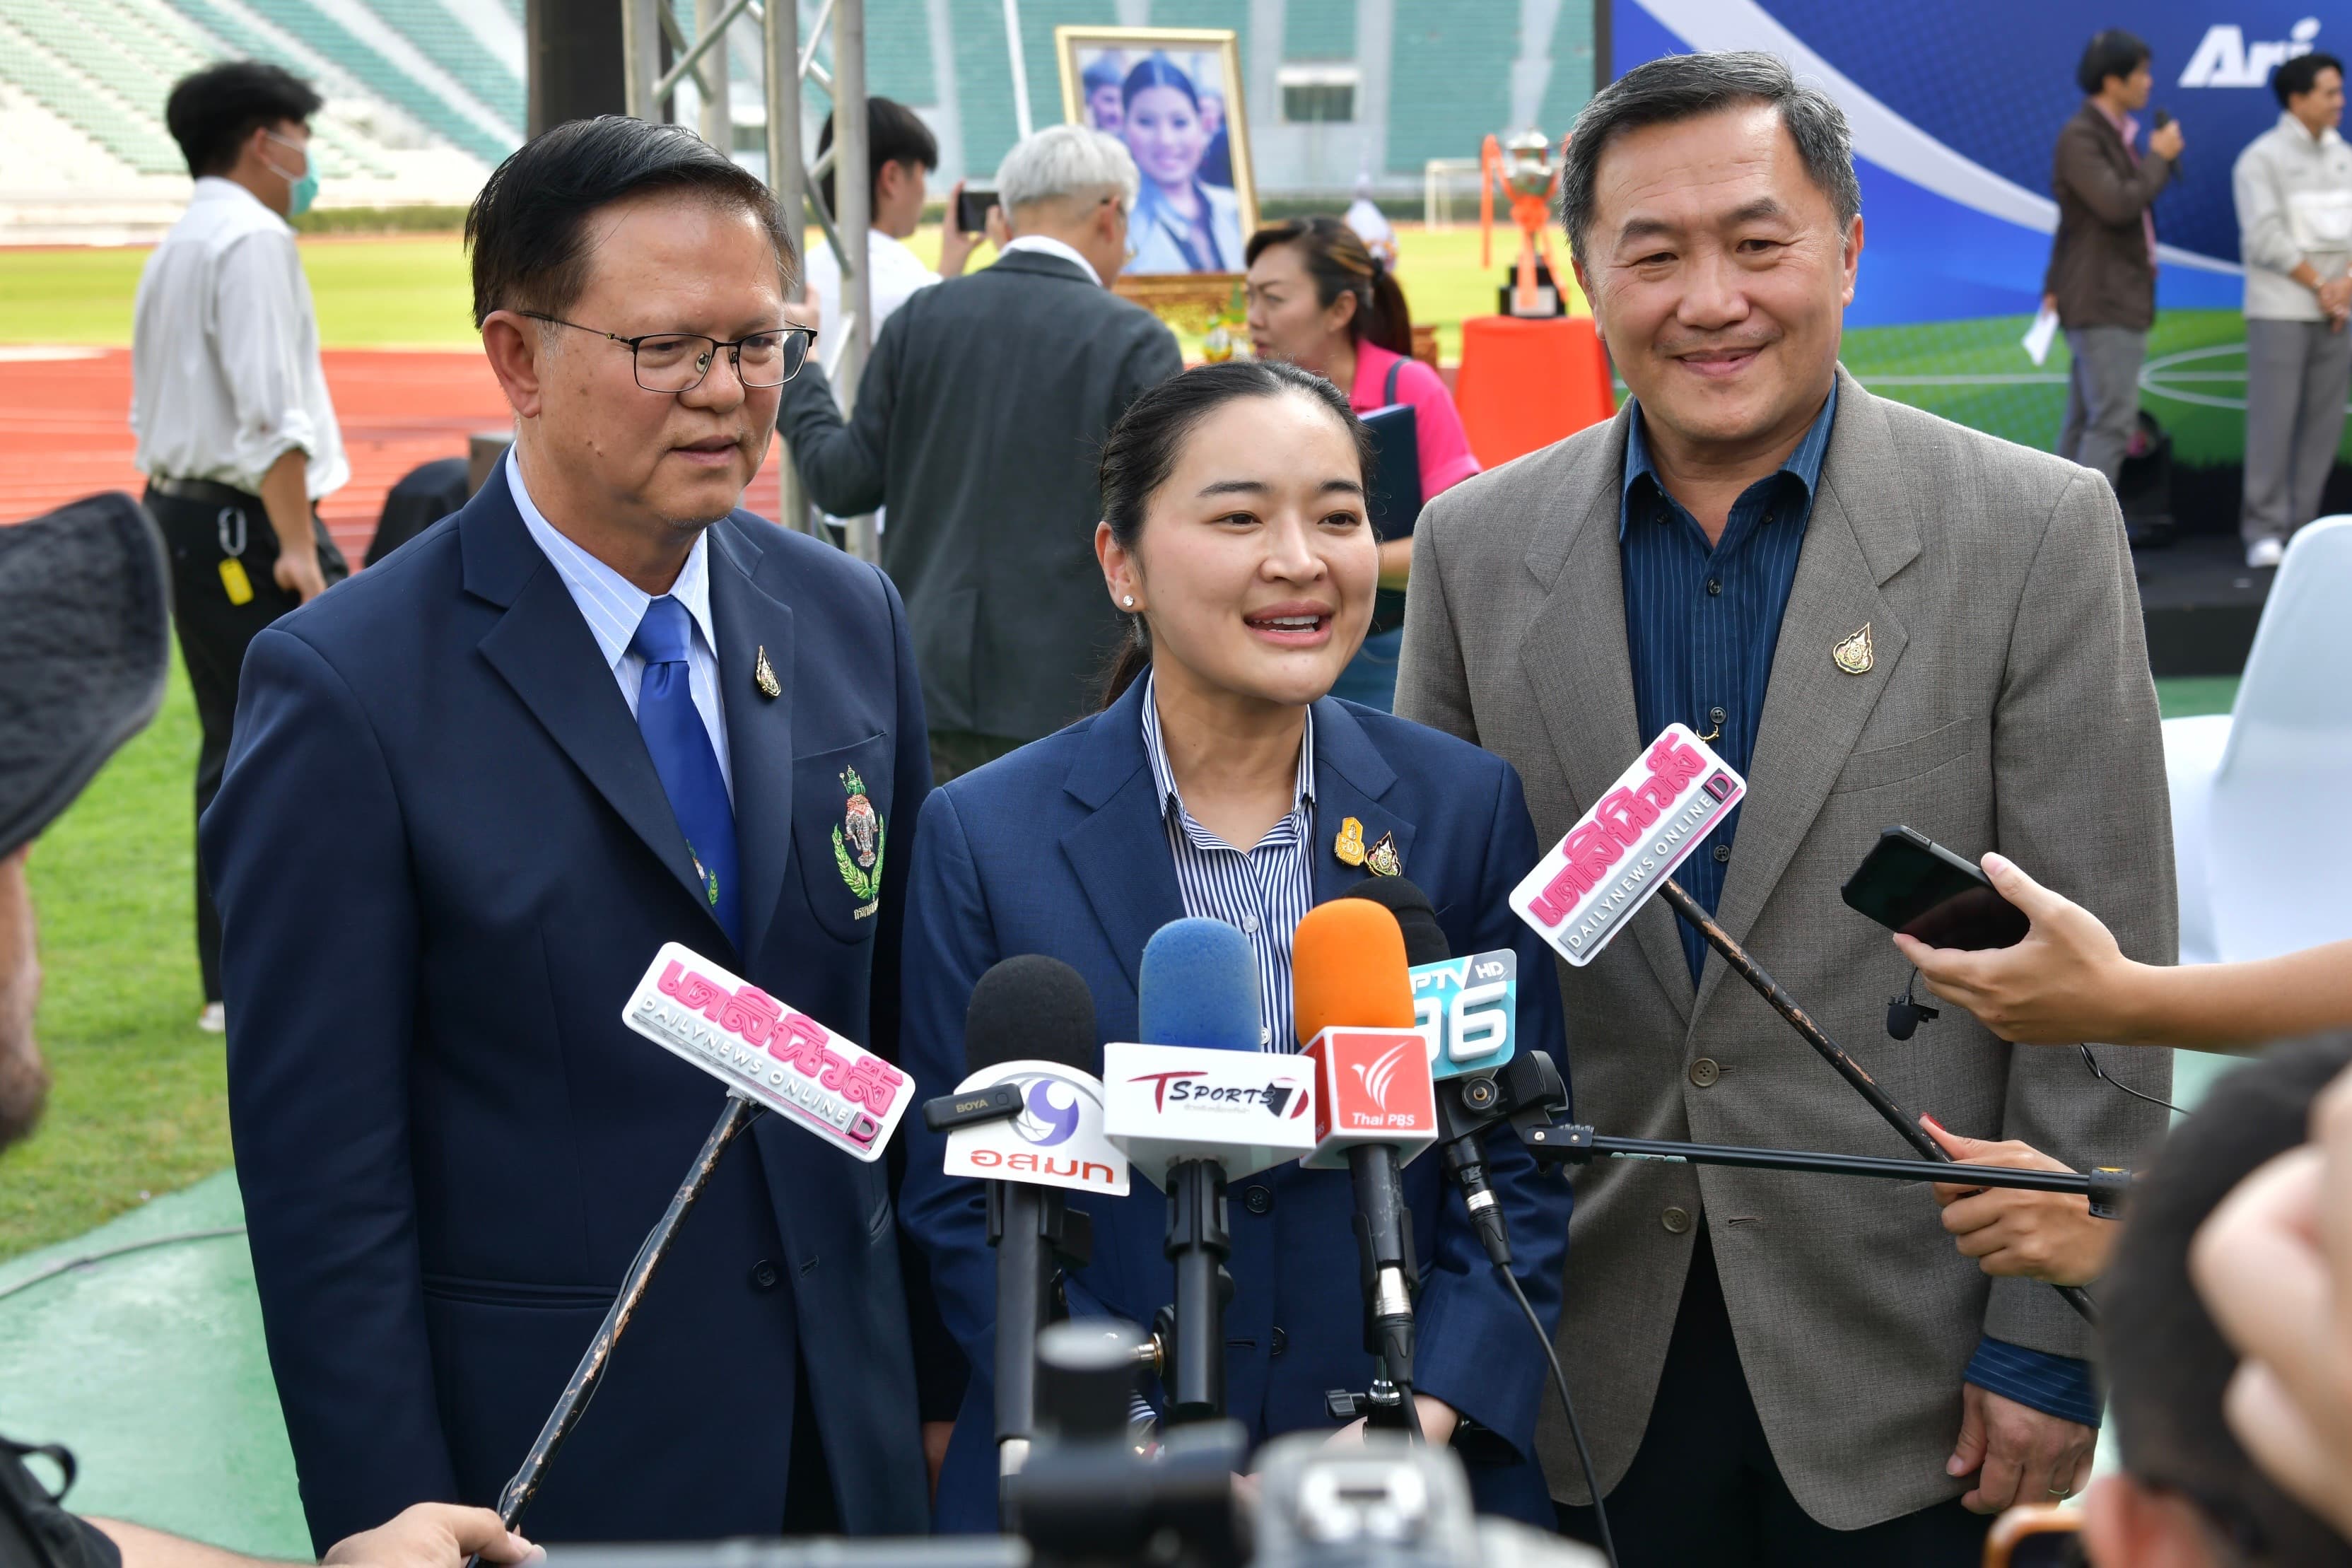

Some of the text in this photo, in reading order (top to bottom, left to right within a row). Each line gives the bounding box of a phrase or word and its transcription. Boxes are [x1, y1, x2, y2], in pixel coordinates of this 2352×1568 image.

[2178, 16, 2322, 88] Ari
[1567, 856, 1655, 949] DAILYNEWS
[1654, 795, 1713, 857] ONLINE
[1409, 955, 1504, 995] PTV HD
[640, 997, 763, 1075] DAILYNEWS
[769, 1069, 849, 1125] ONLINE
[956, 1098, 988, 1113] BOYA
[1352, 1112, 1416, 1127] Thai PBS
